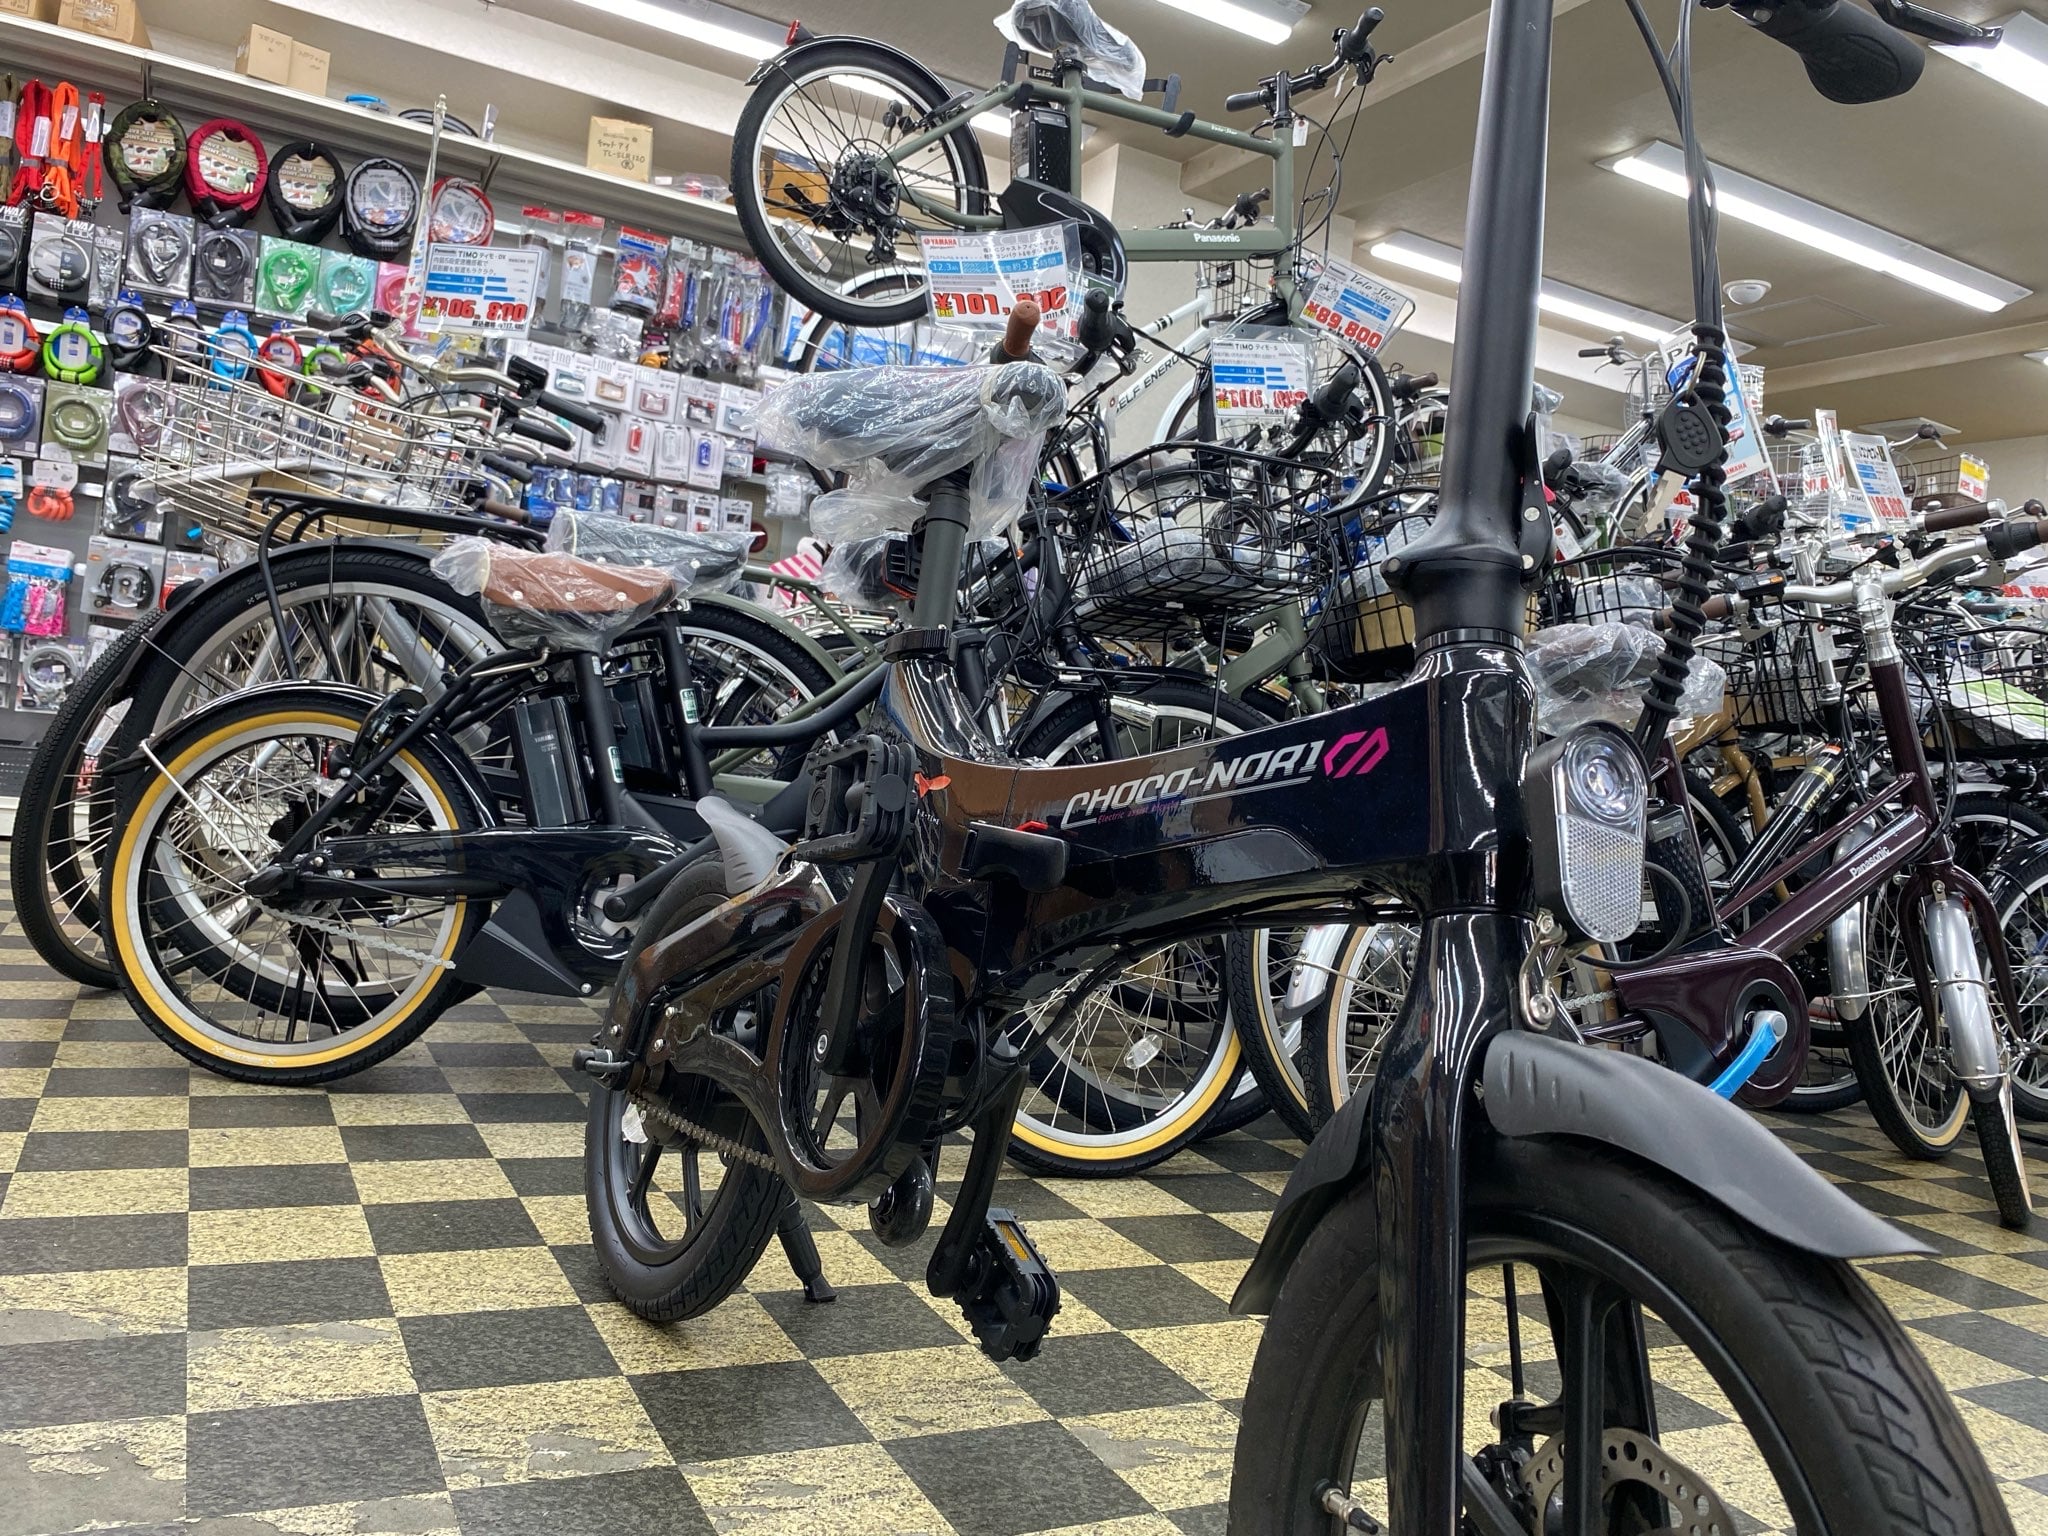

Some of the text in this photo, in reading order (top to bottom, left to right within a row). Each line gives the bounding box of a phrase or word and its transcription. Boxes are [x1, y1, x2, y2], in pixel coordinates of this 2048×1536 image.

[930, 237, 957, 246] YAMAHA
[1194, 232, 1240, 243] Panasonic
[458, 250, 478, 259] TIMO
[1307, 300, 1383, 349] ¥89,800
[1235, 343, 1254, 351] TIMO
[1116, 386, 1141, 413] ELF
[1725, 462, 1747, 475] AMAHA
[1097, 811, 1125, 824] Electric
[1850, 845, 1890, 879] Panasonic
